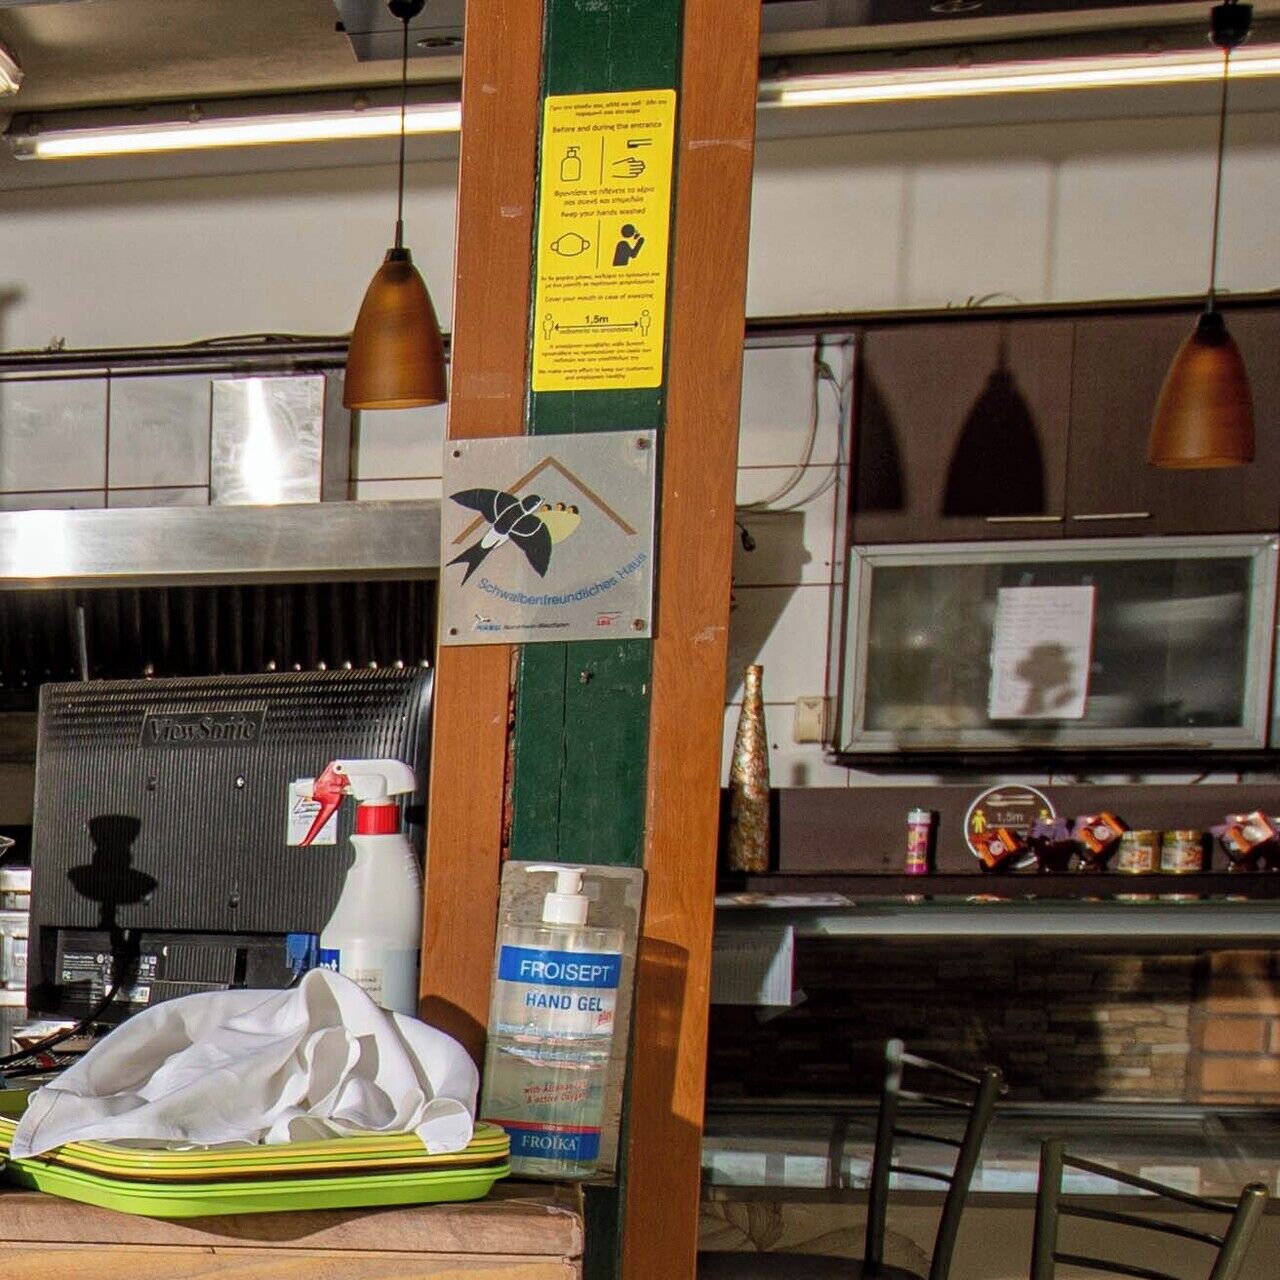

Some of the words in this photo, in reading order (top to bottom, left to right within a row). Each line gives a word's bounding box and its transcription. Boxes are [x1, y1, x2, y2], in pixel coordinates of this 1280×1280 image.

[552, 125, 575, 133] Before
[577, 124, 590, 132] and
[592, 123, 615, 132] during
[616, 122, 629, 130] the
[580, 210, 595, 218] your
[584, 315, 609, 324] 1.5m
[477, 576, 618, 606] Schwalbenfreundliches
[616, 552, 648, 580] Haus
[151, 716, 257, 742] ViewSonic
[996, 812, 1024, 823] 1.5m
[520, 960, 610, 982] FROISEPT
[525, 992, 571, 1010] HAND
[577, 995, 603, 1012] GEL
